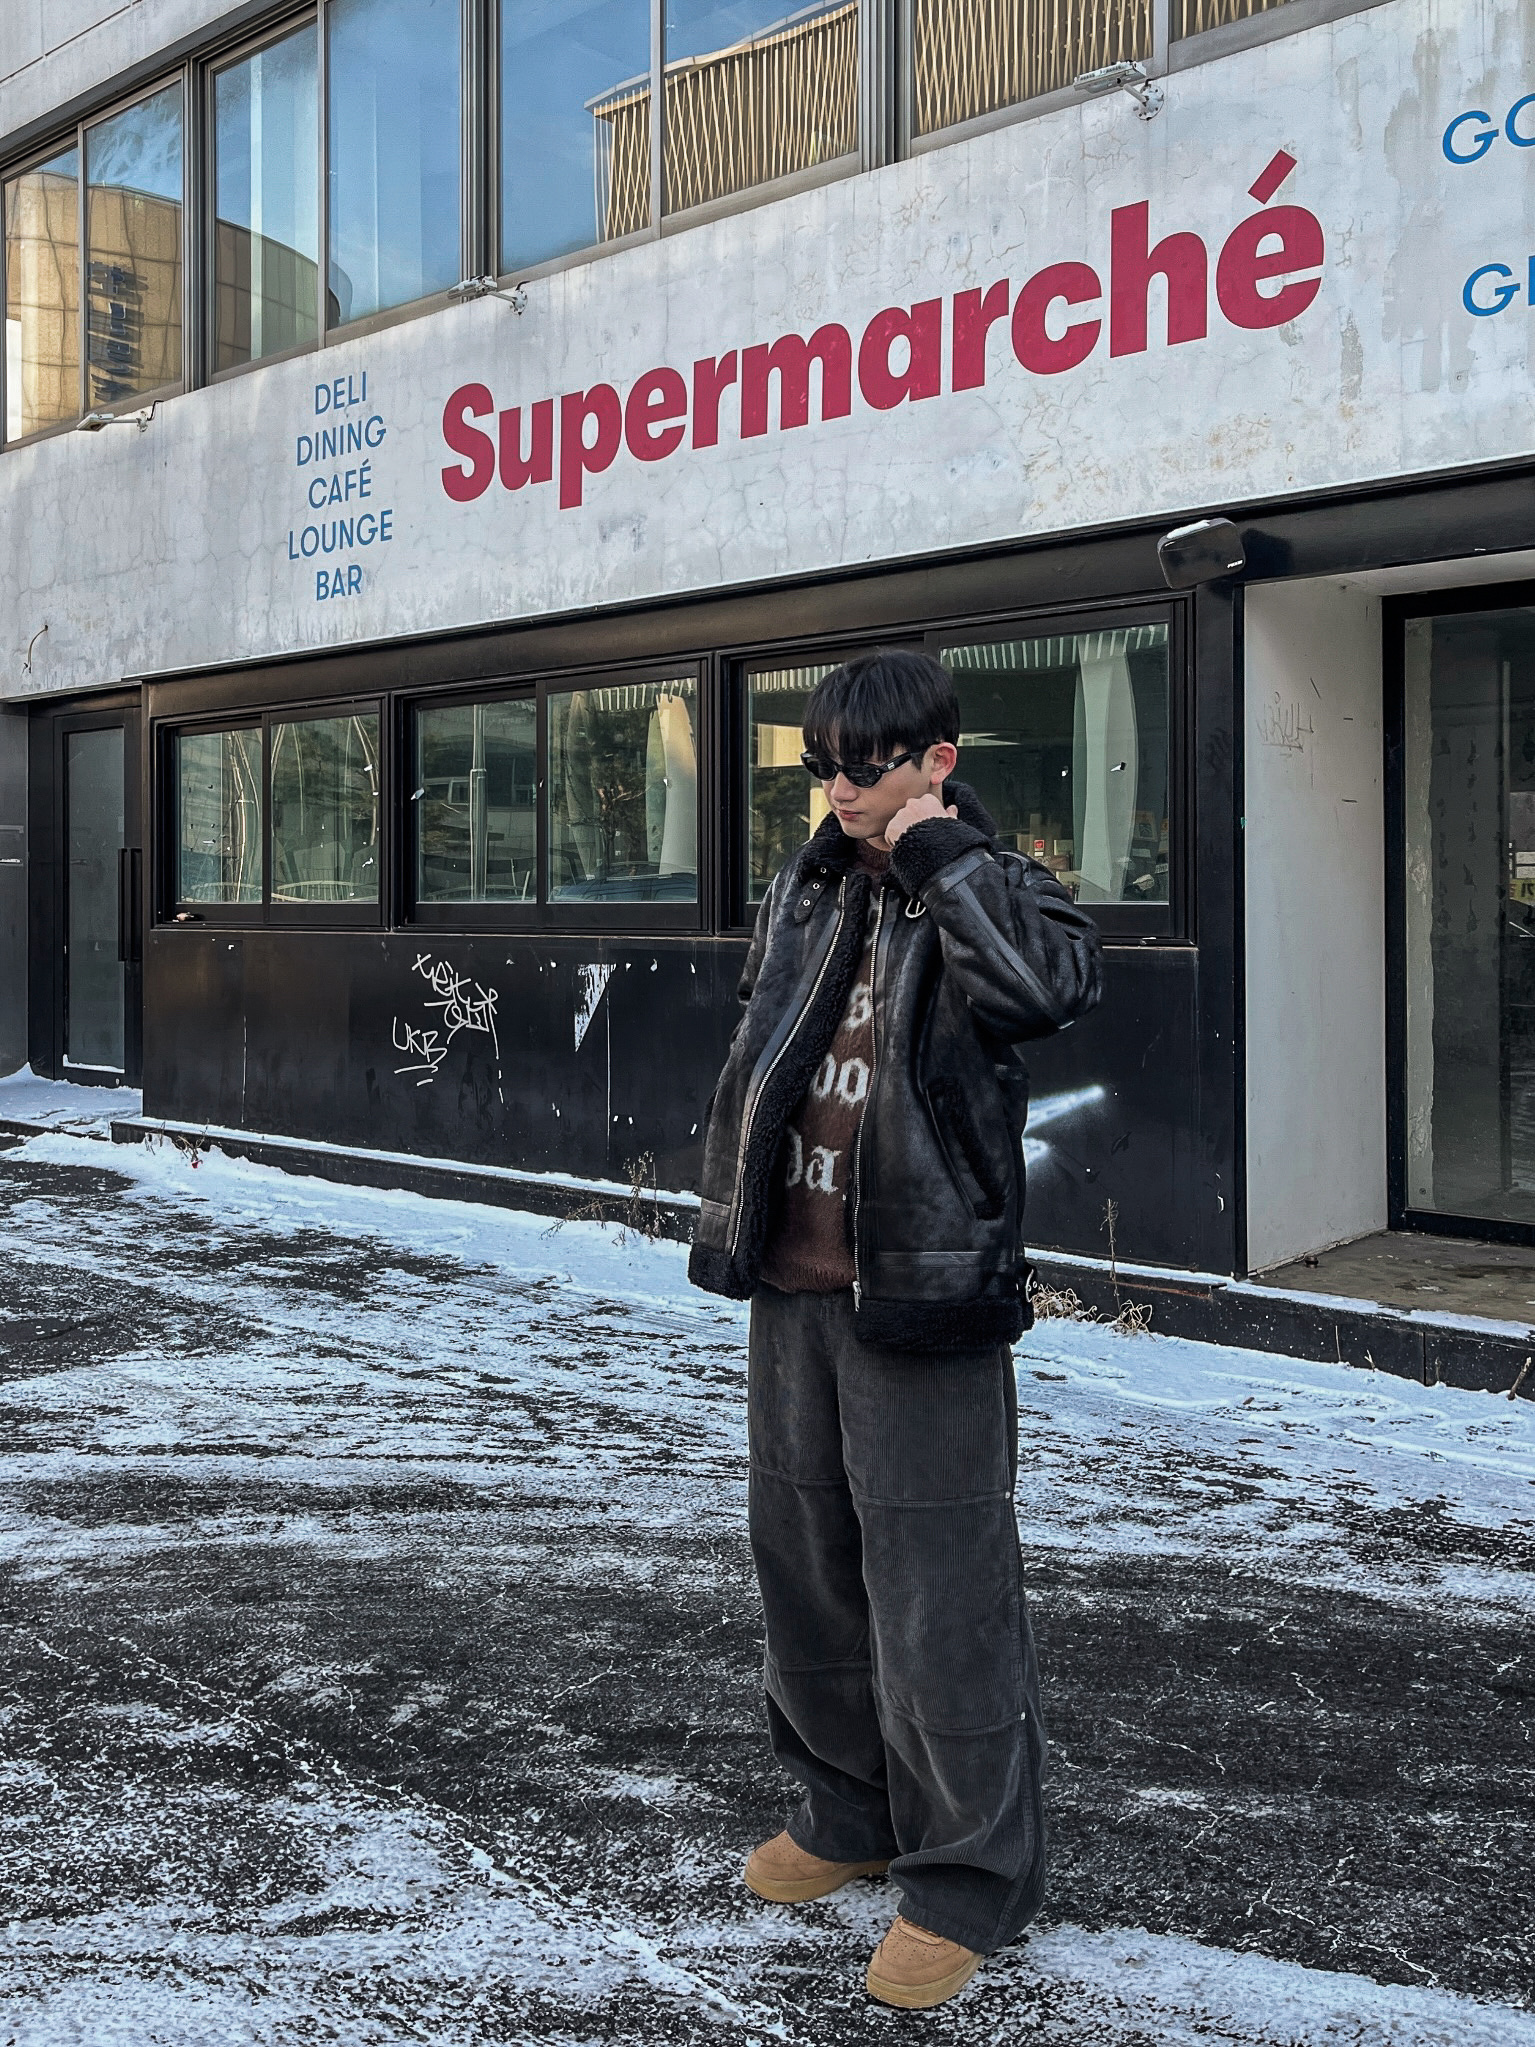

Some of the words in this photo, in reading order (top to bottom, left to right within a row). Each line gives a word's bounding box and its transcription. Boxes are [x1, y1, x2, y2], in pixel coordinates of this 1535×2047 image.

[1462, 255, 1535, 317] G
[442, 150, 1325, 509] Supermarché
[315, 371, 367, 415] DELI
[296, 415, 387, 467] DINING
[308, 458, 372, 509] CAFÉ
[288, 509, 393, 561] LOUNGE
[316, 564, 363, 601] BAR
